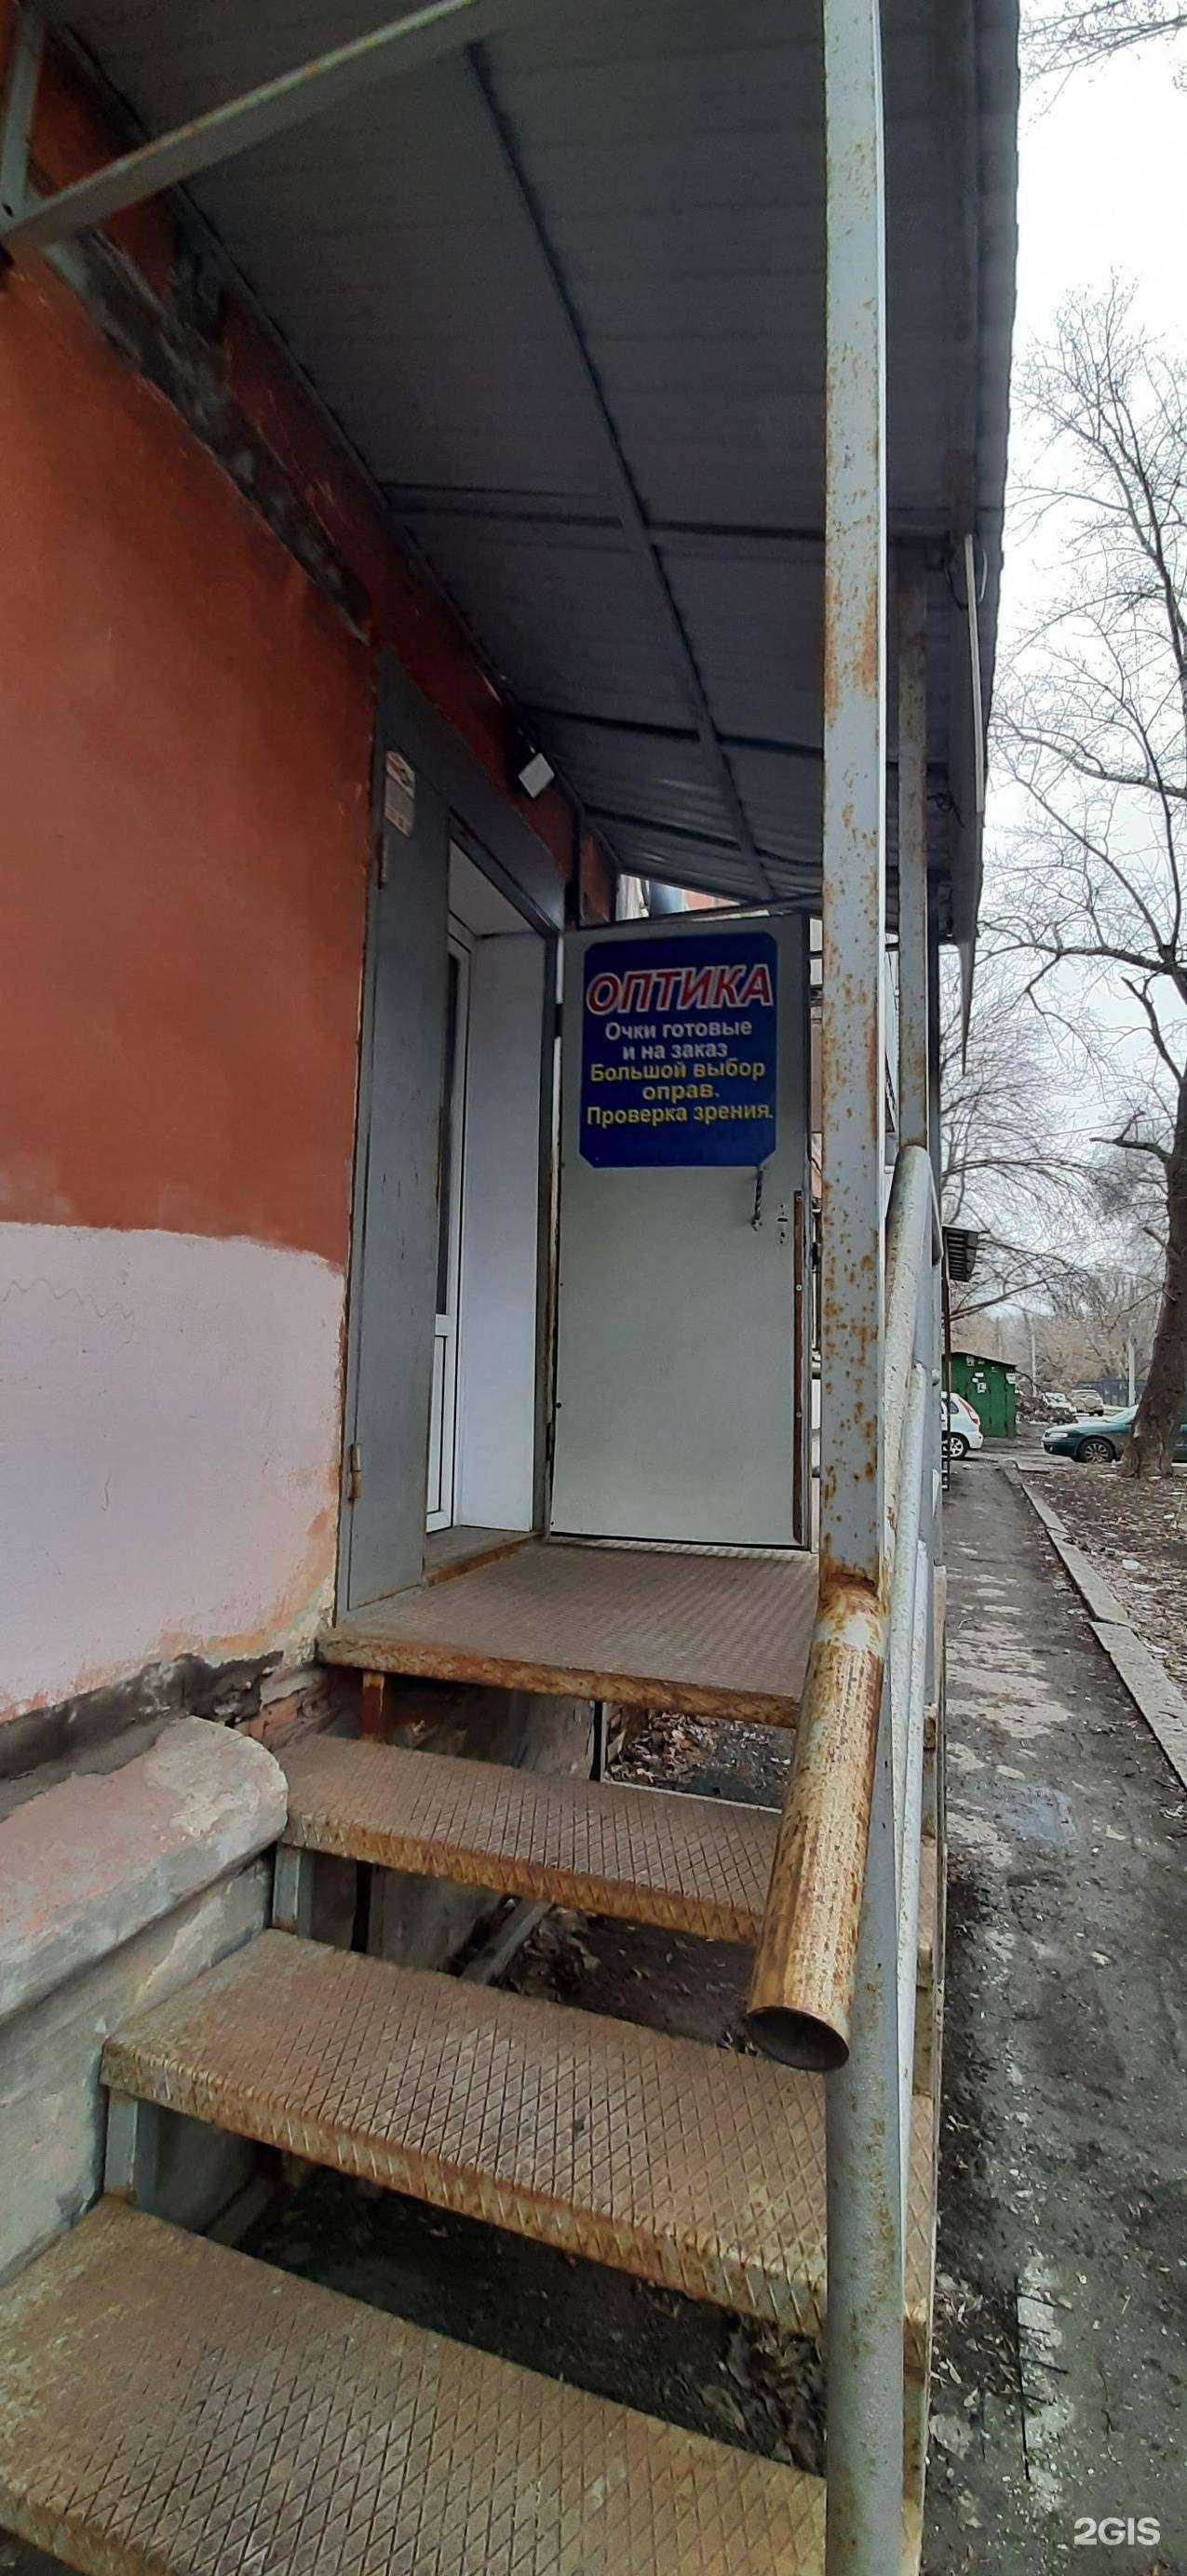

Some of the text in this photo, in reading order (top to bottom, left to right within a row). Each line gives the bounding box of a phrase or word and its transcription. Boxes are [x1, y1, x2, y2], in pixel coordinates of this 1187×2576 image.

[586, 963, 775, 1015] ОПТИКА
[605, 1020, 753, 1040] Очки готовые
[622, 1042, 728, 1060] и на заказ
[590, 1057, 765, 1081] Большой выбор
[641, 1084, 721, 1104] оправ.
[587, 1104, 775, 1129] Проверка зрения.
